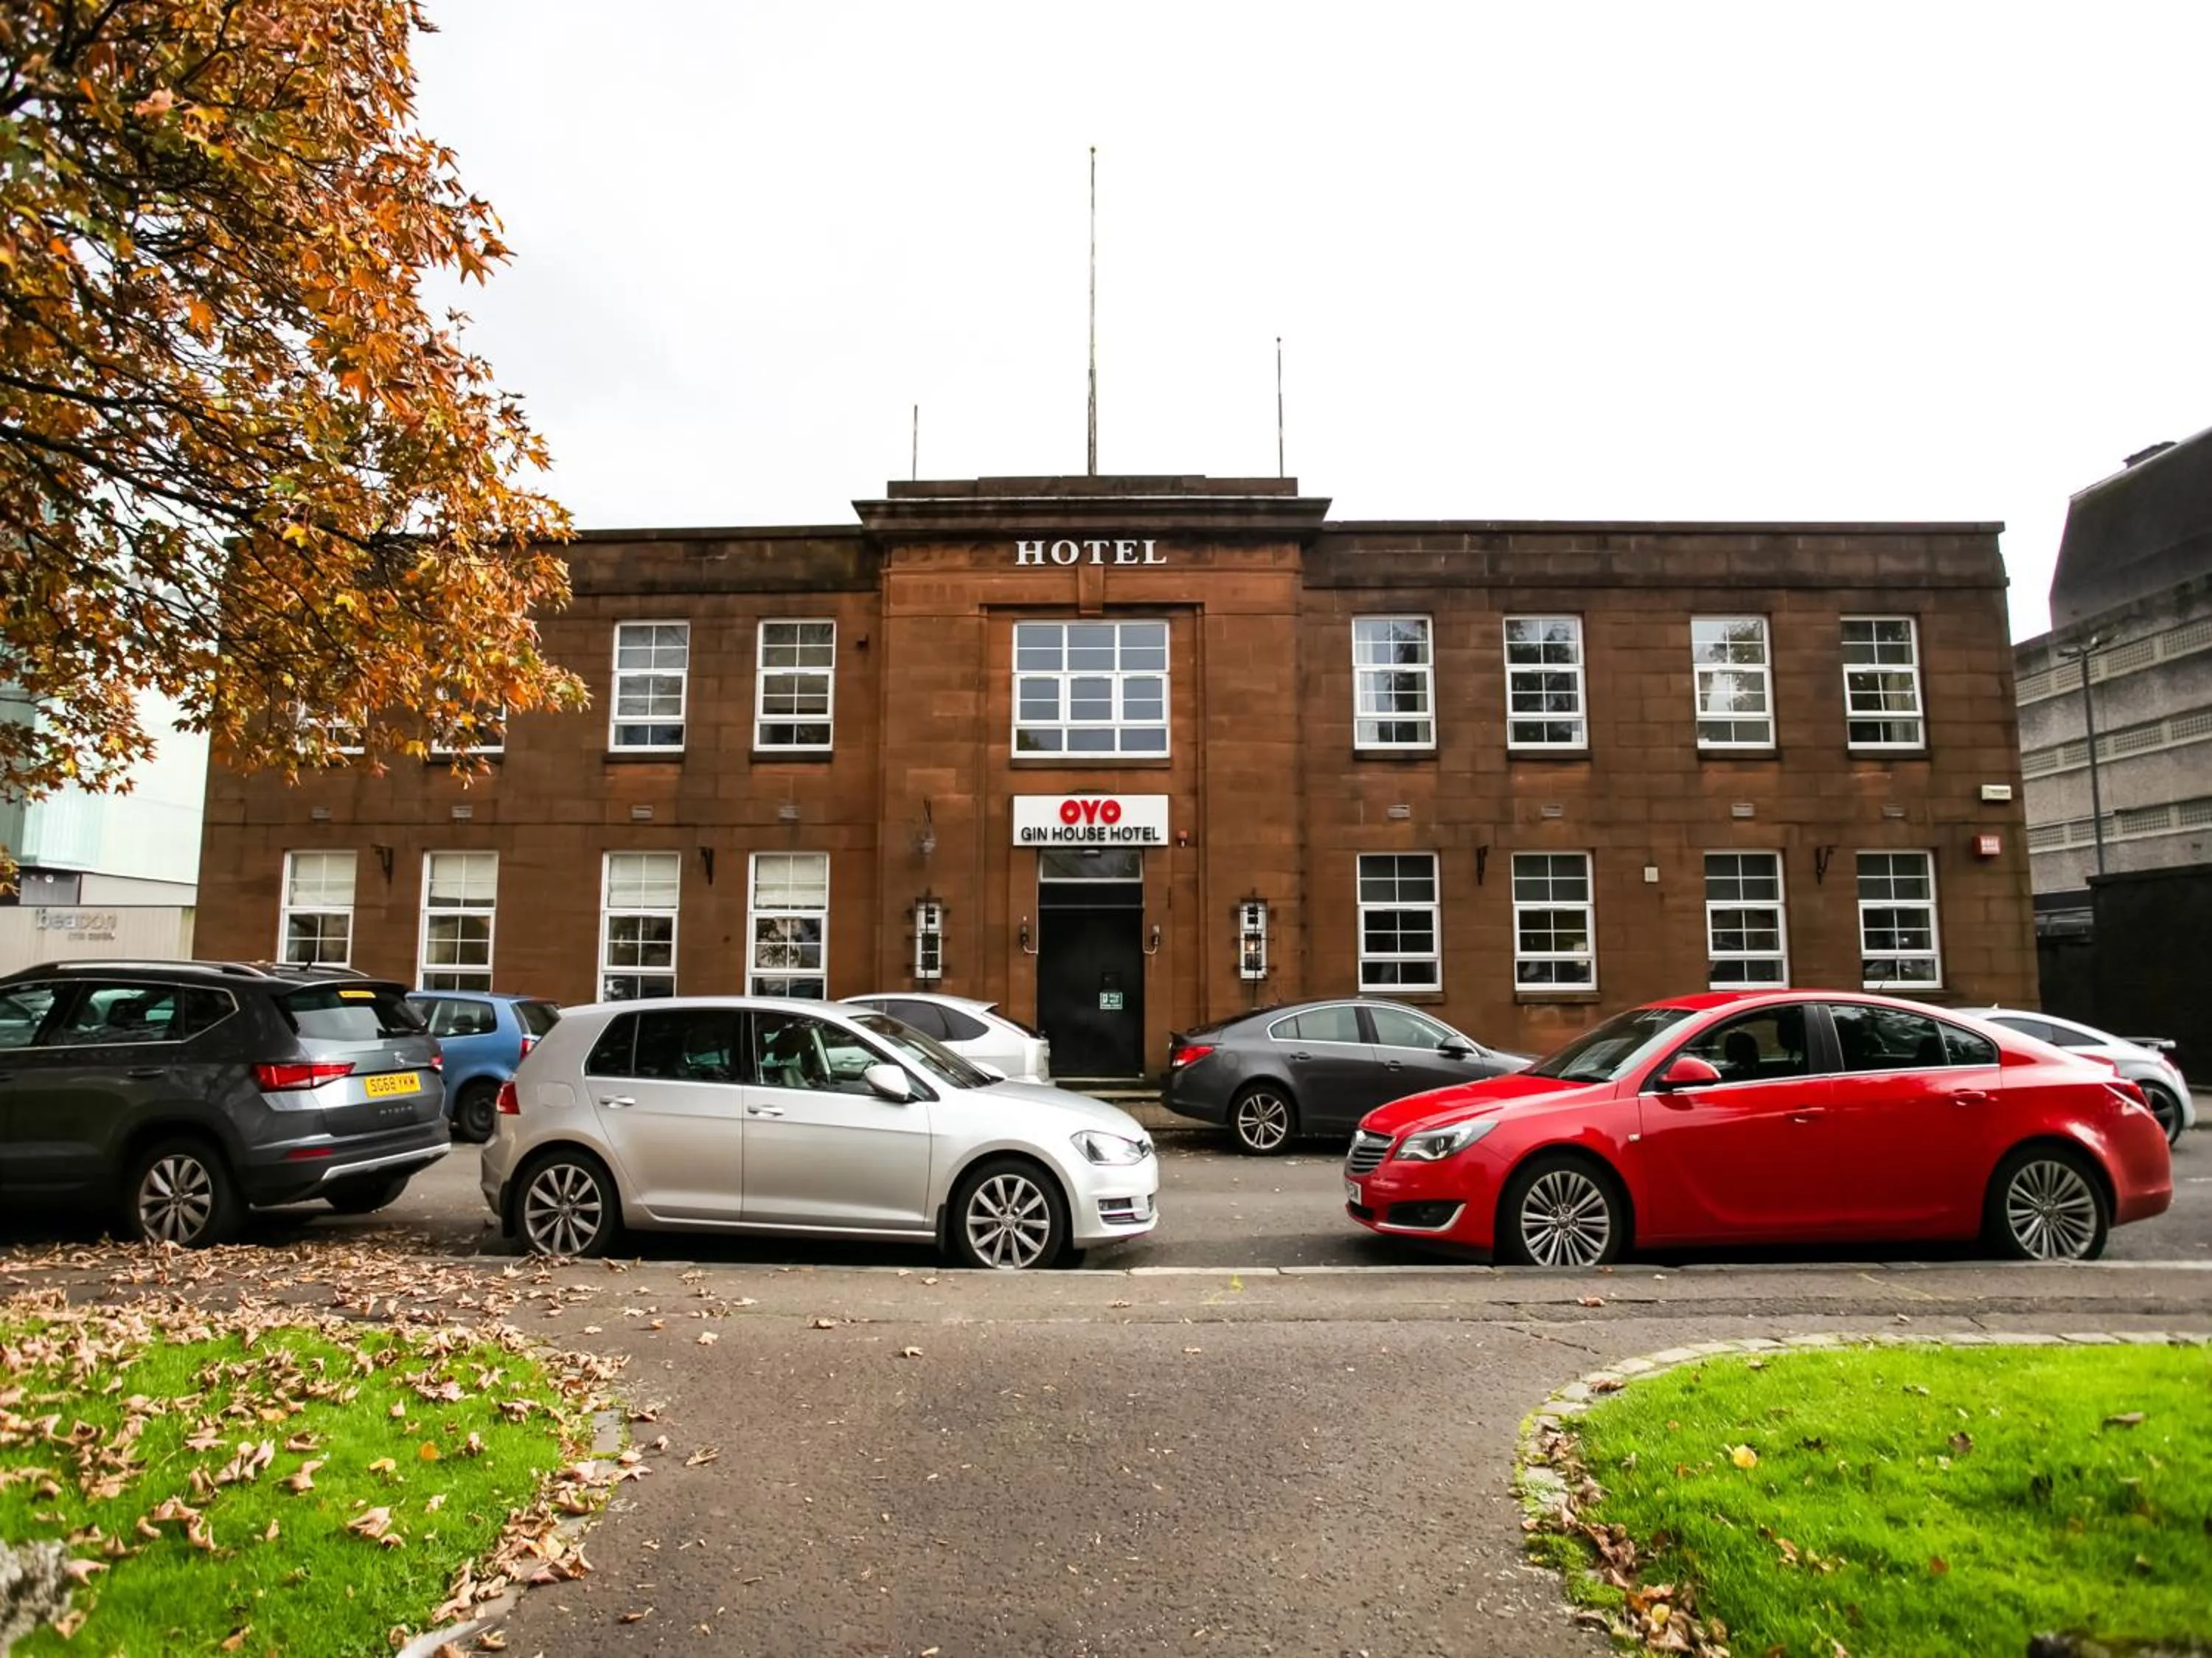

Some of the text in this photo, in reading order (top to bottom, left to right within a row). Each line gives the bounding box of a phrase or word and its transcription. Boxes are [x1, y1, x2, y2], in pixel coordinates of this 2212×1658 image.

[1015, 539, 1168, 566] HOTEL
[1059, 799, 1122, 825] OYO
[1020, 826, 1161, 842] GIN HOUSE HOTEL
